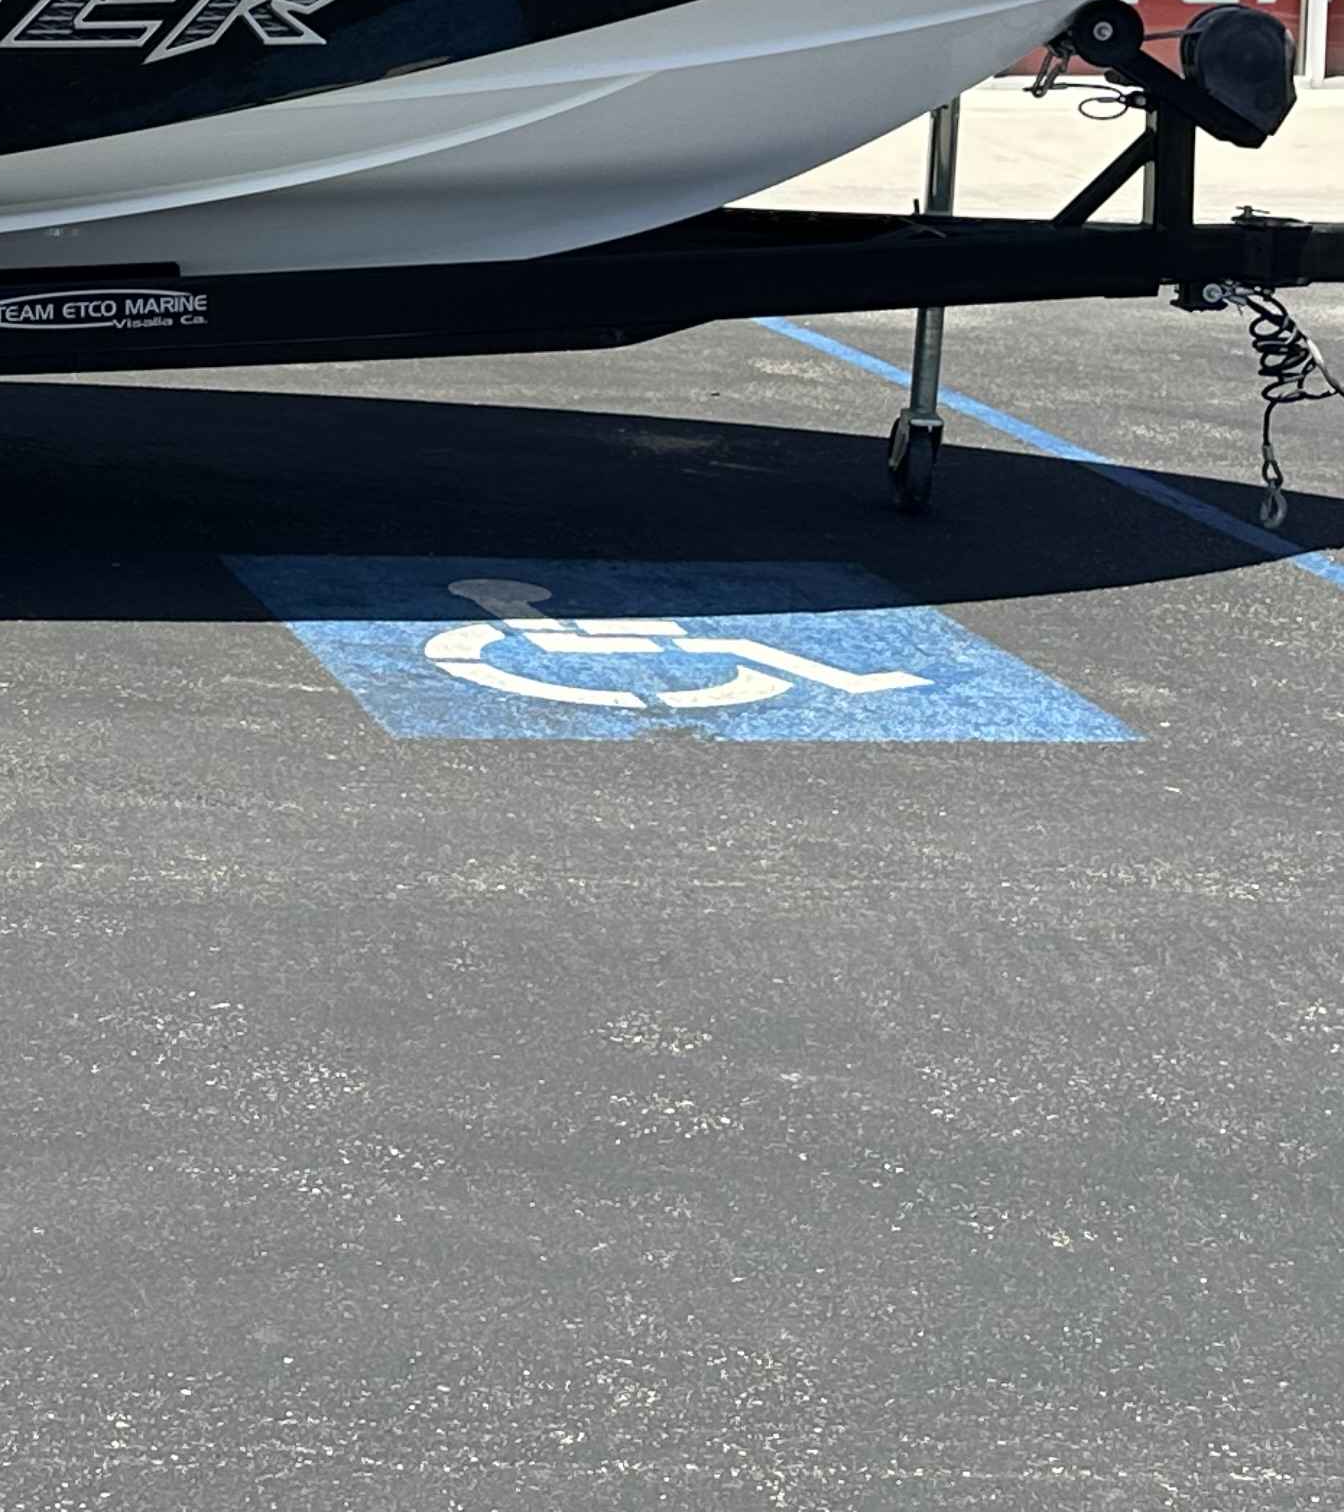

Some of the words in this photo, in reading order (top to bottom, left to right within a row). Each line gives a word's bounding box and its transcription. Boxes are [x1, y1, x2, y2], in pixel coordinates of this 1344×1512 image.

[62, 299, 117, 319] ETCO
[124, 294, 208, 316] MARINE
[112, 317, 174, 329] Visalia
[179, 313, 209, 326] Ca.
